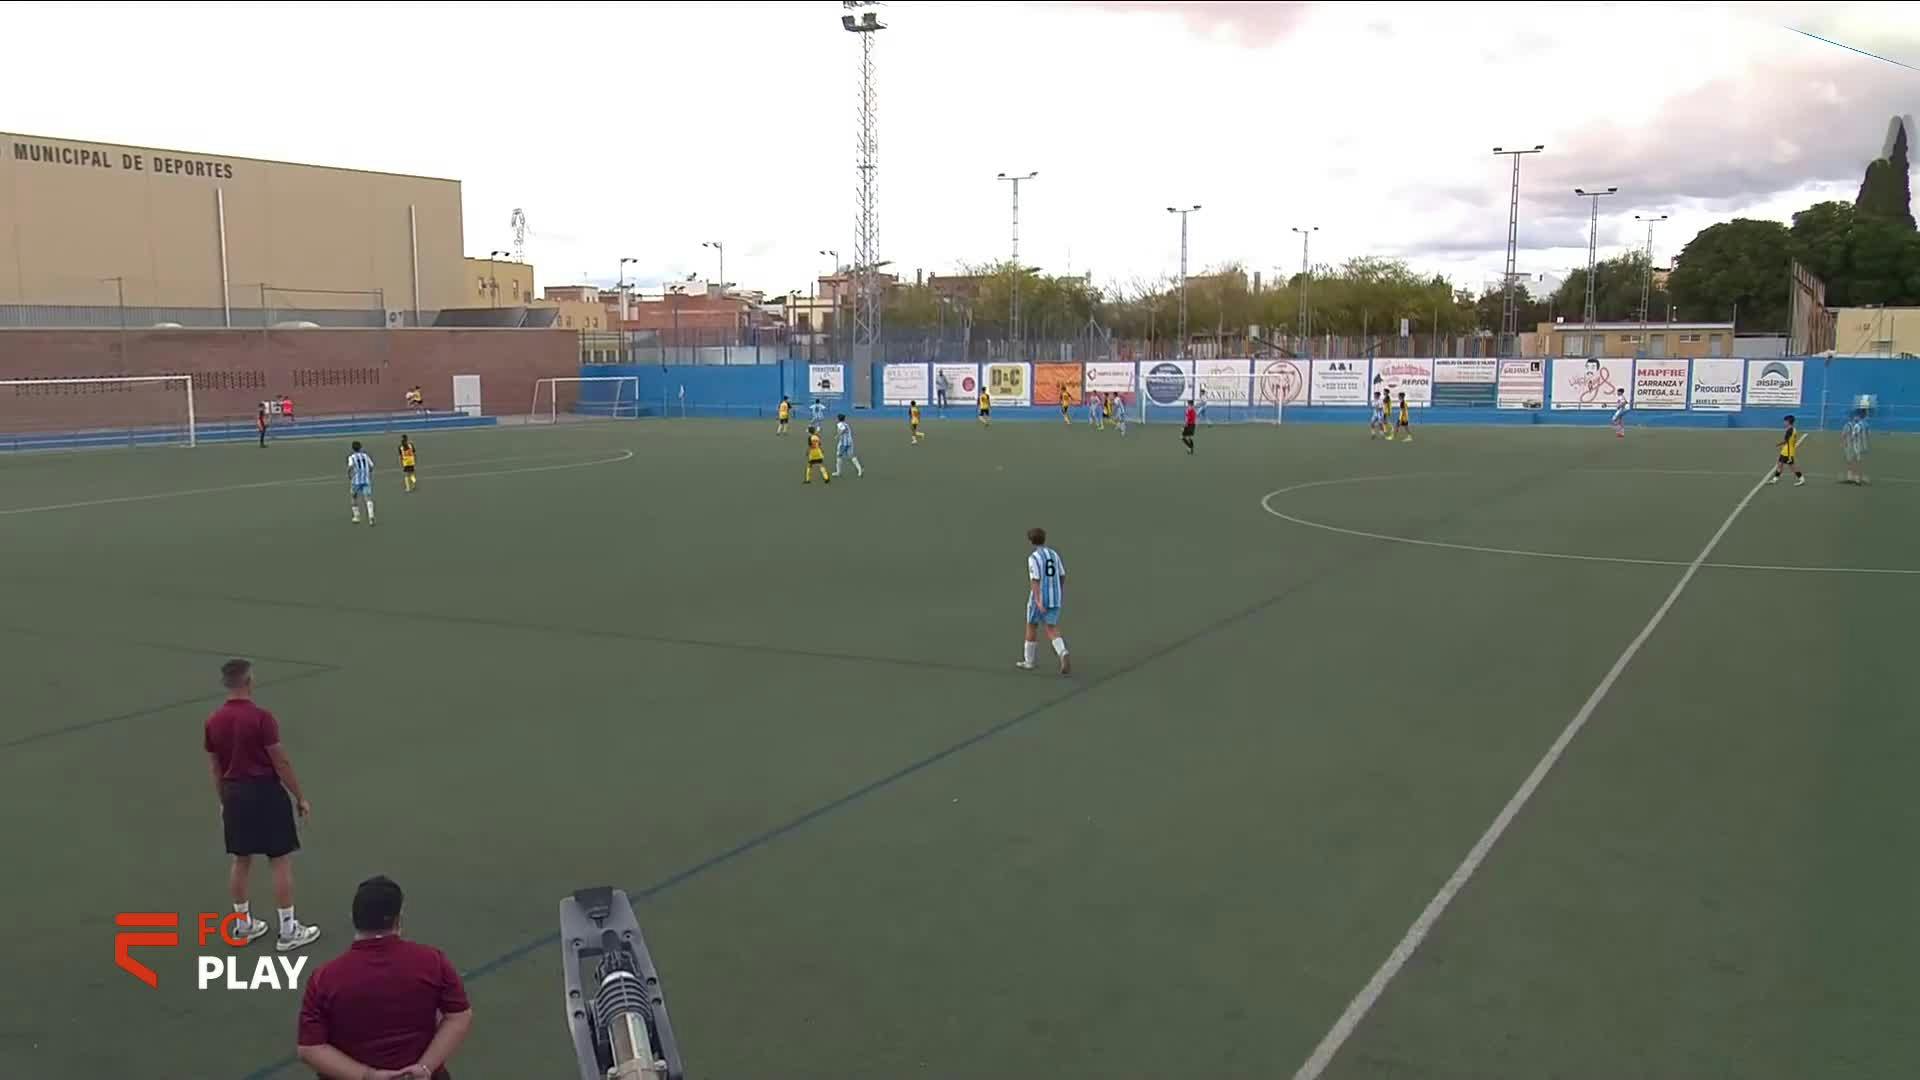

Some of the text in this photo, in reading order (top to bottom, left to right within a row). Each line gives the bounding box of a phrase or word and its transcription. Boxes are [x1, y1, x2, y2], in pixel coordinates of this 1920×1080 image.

[14, 143, 233, 179] MUNICIPAL DE DEPORTES
[1329, 362, 1337, 371] A
[1637, 369, 1686, 377] MAPFRE
[1402, 378, 1429, 386] REPSOL
[1045, 559, 1056, 577] 6
